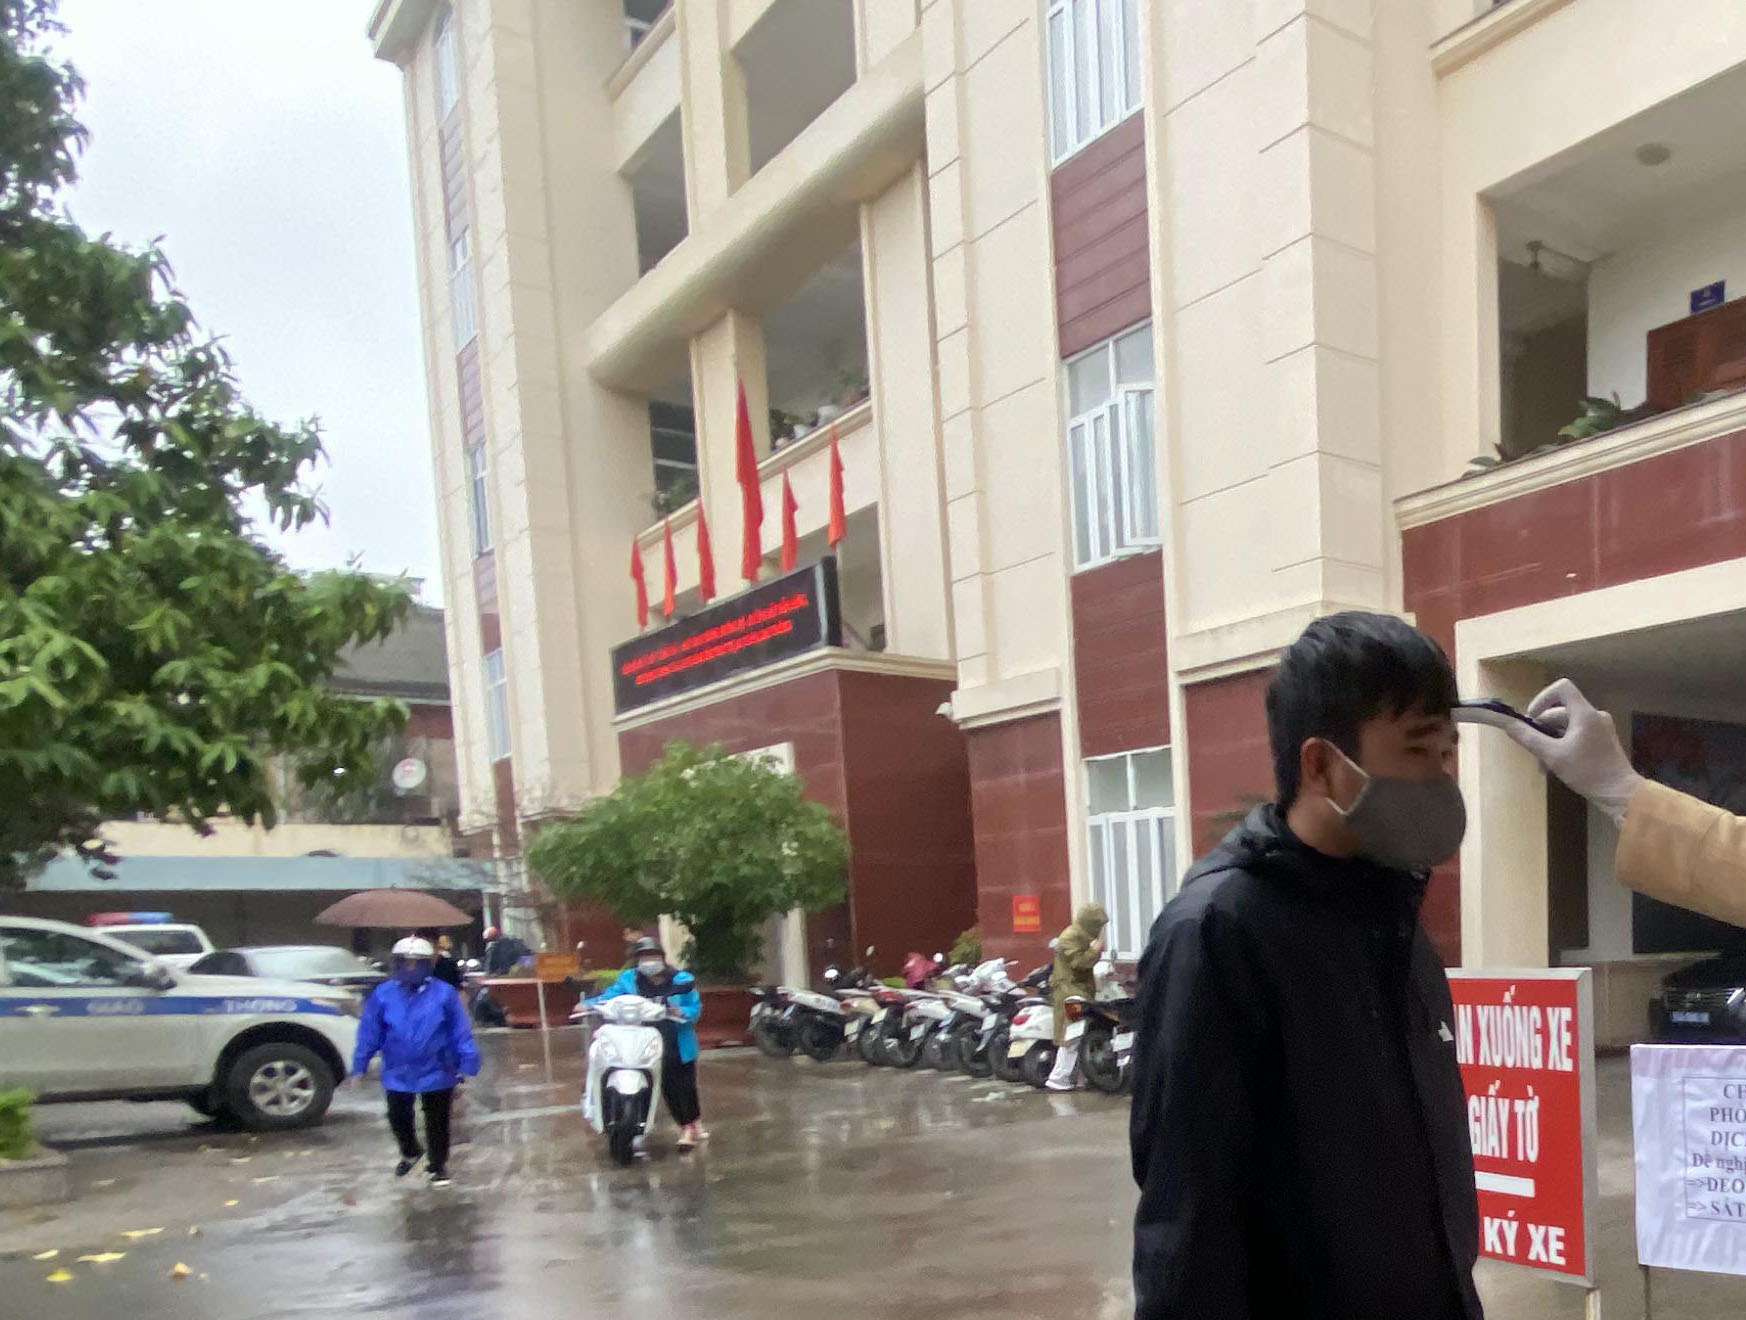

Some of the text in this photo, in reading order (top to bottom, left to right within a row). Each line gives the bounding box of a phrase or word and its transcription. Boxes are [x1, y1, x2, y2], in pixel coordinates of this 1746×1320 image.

[1476, 984, 1543, 1070] XUỐNG
[1546, 1007, 1573, 1072] XE
[1468, 1080, 1540, 1163] GIẤY TỜ
[1483, 1210, 1566, 1266] KÝ XE
